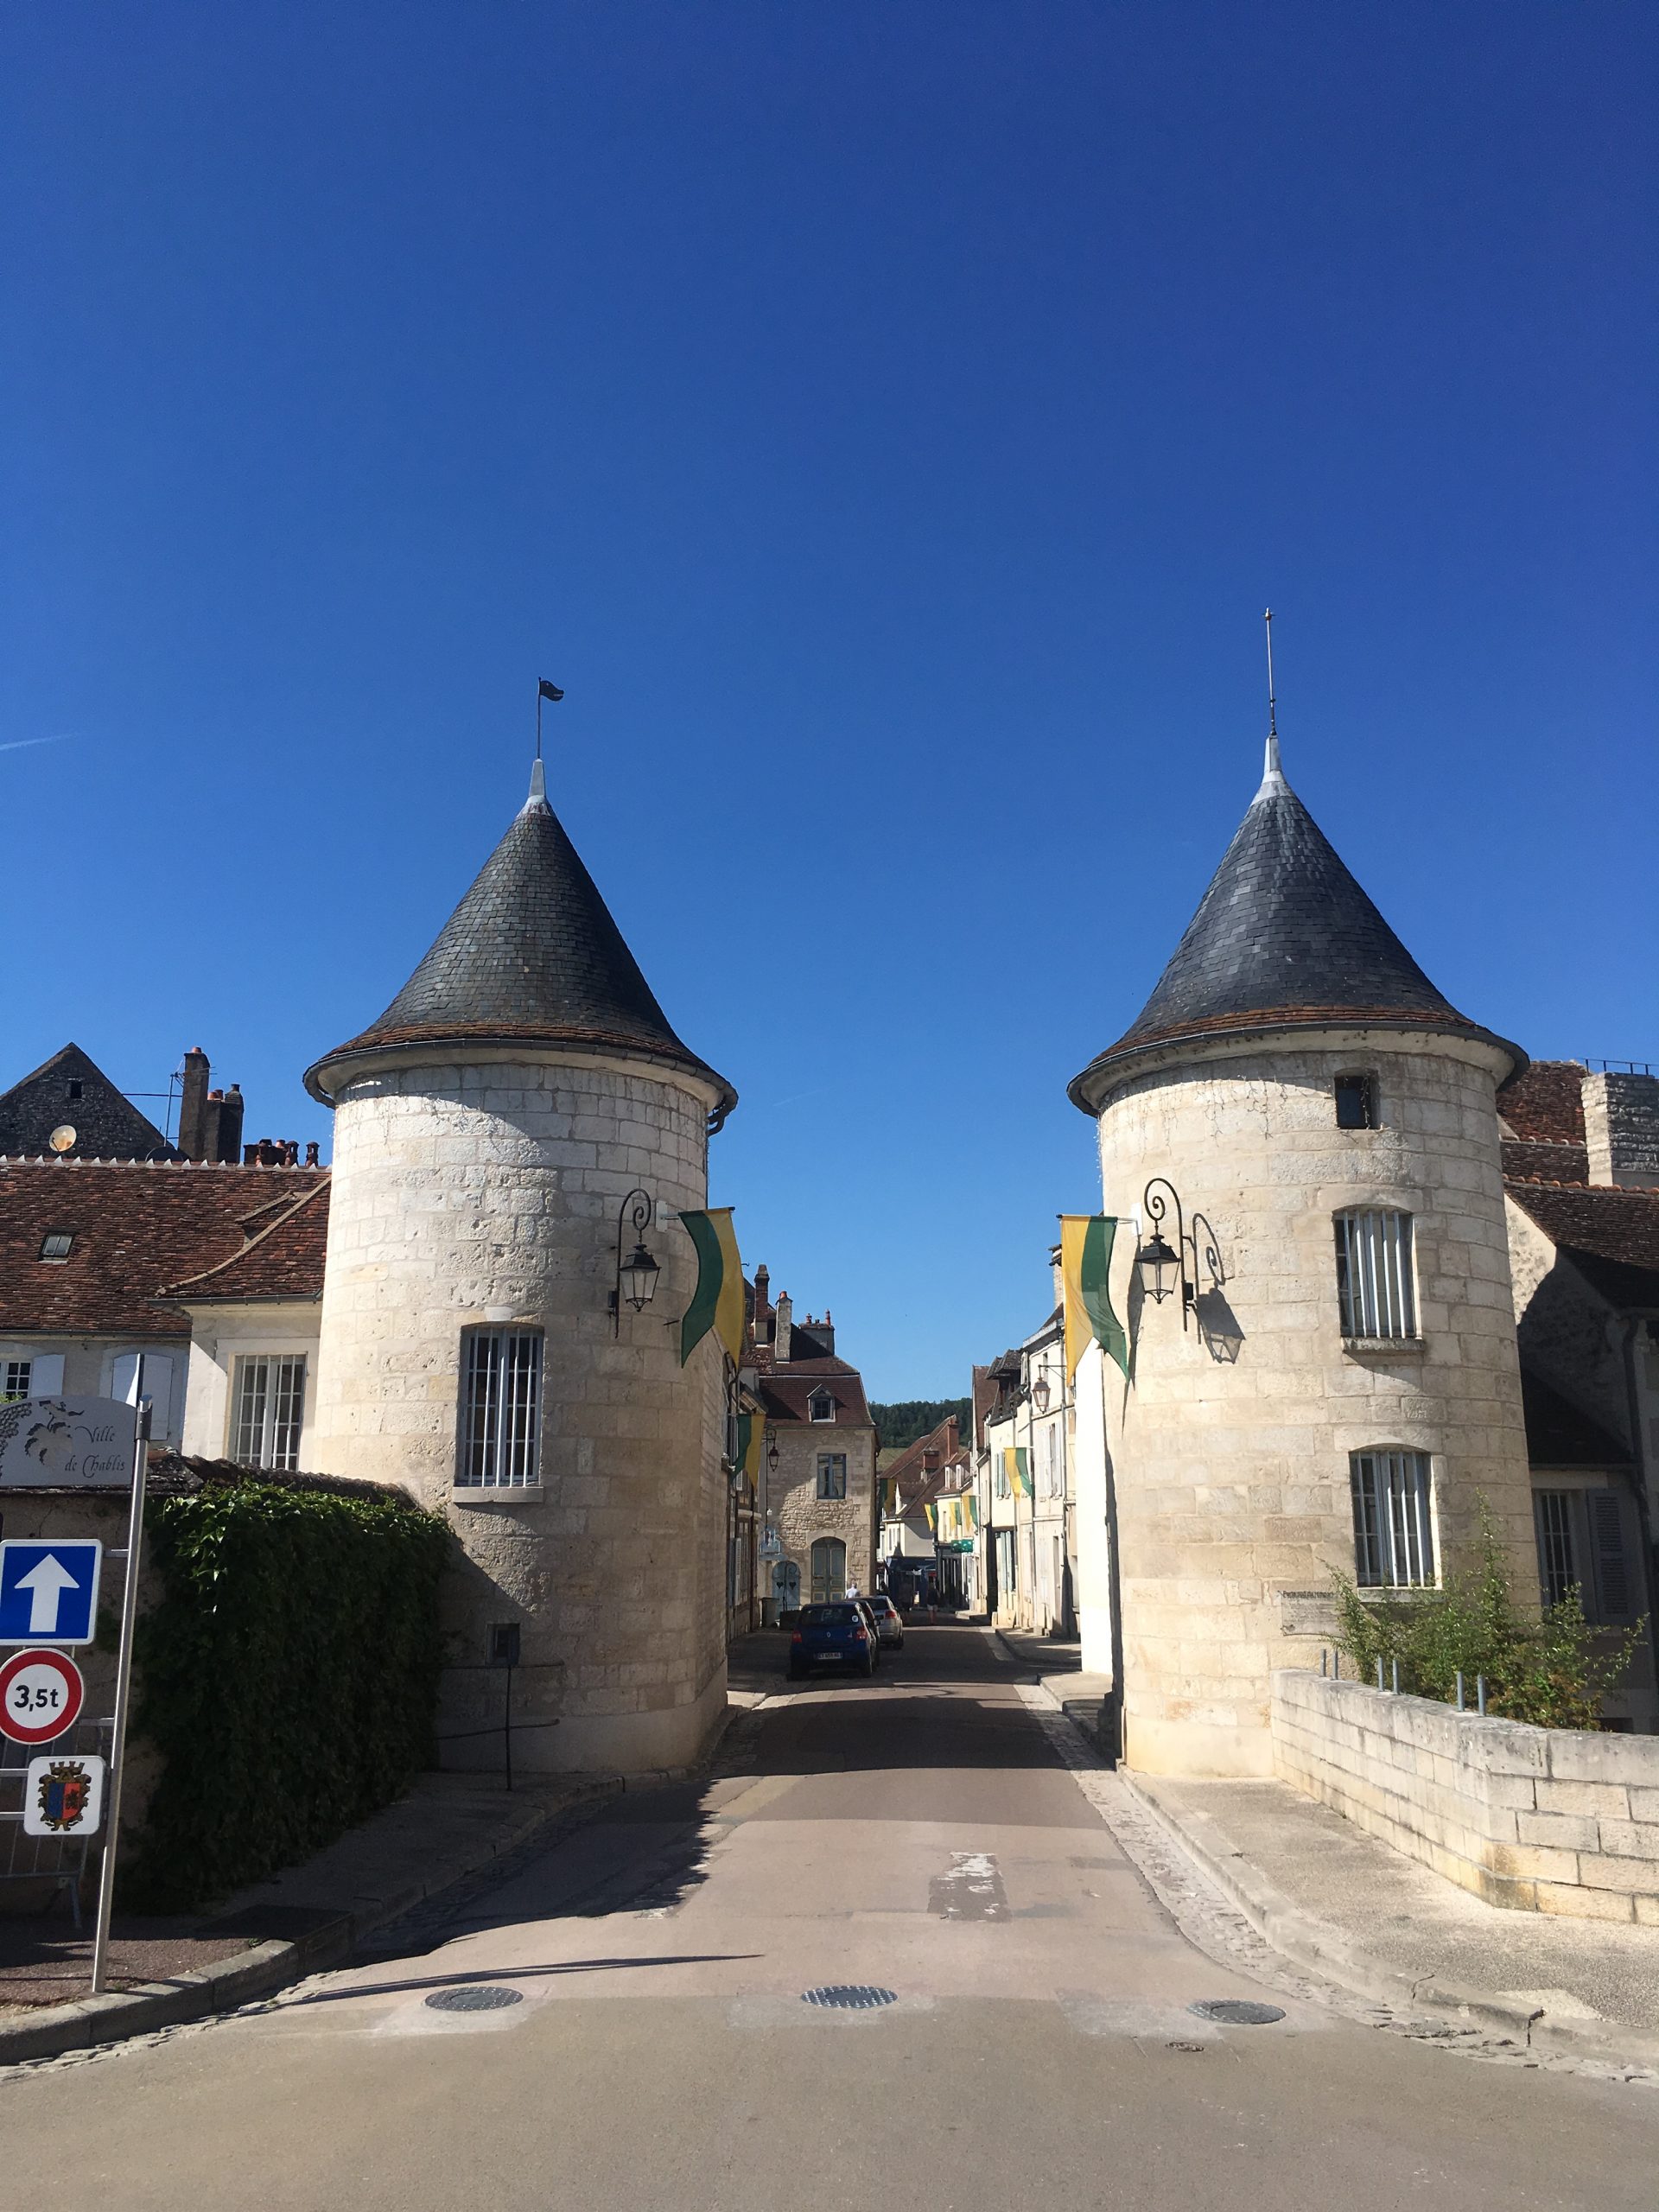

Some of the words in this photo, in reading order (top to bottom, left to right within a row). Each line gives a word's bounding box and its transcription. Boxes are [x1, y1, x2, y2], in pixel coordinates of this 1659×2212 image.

[74, 1426, 115, 1444] Ville
[64, 1454, 78, 1471] de
[82, 1454, 125, 1478] Chablis
[14, 1684, 59, 1713] 3,5t
